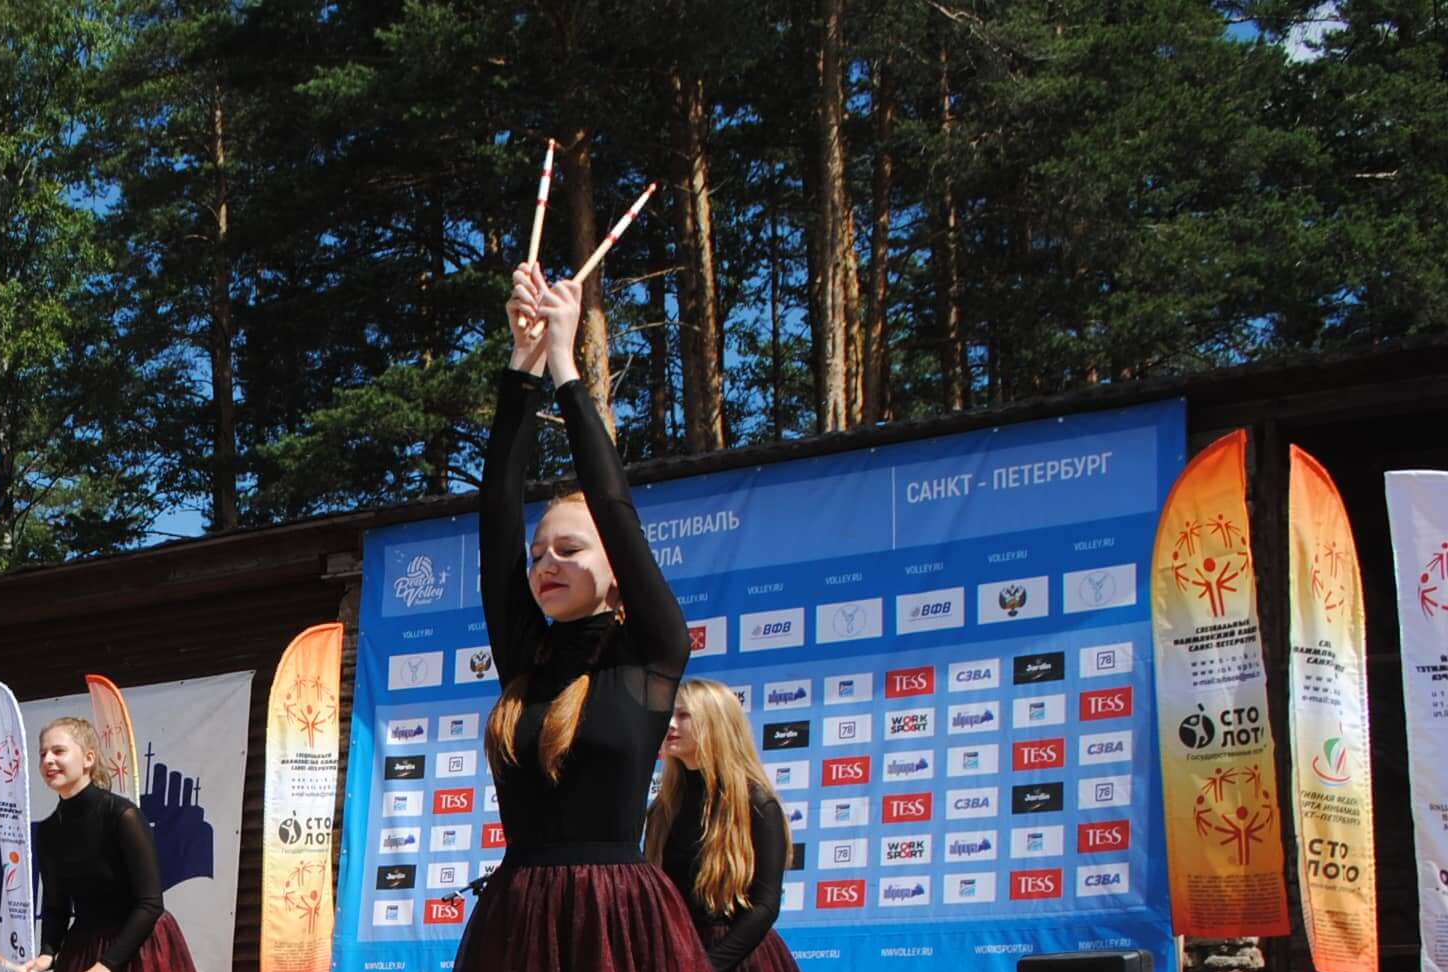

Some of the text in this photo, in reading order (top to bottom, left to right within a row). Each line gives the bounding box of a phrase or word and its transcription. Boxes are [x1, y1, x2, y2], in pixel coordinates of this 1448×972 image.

[906, 474, 972, 504] САНКТ
[992, 452, 1113, 490] ПЕТЕРБУРГ
[921, 601, 951, 617] ВФВ
[763, 621, 791, 635] ВФВ
[894, 672, 927, 692] TESS
[1088, 693, 1125, 714] TESS
[891, 714, 928, 727] WORK
[1220, 706, 1260, 726] СТО
[842, 724, 853, 736] 78
[1221, 727, 1264, 747] ЛОТ
[1020, 744, 1057, 765] TESS
[830, 762, 864, 780] TESS
[440, 794, 468, 809] TESS
[891, 799, 925, 817] TESS
[306, 817, 332, 830] СТО
[304, 833, 332, 845] ЛОТ
[488, 828, 505, 843] TE
[1086, 826, 1122, 847] TESS
[887, 840, 924, 851] WORK
[1308, 838, 1349, 859] СТО
[838, 850, 848, 859] 78
[1017, 873, 1055, 894] TESS
[1084, 873, 1121, 887] СЗВА
[824, 885, 858, 903] TESS
[432, 903, 459, 919] TESS
